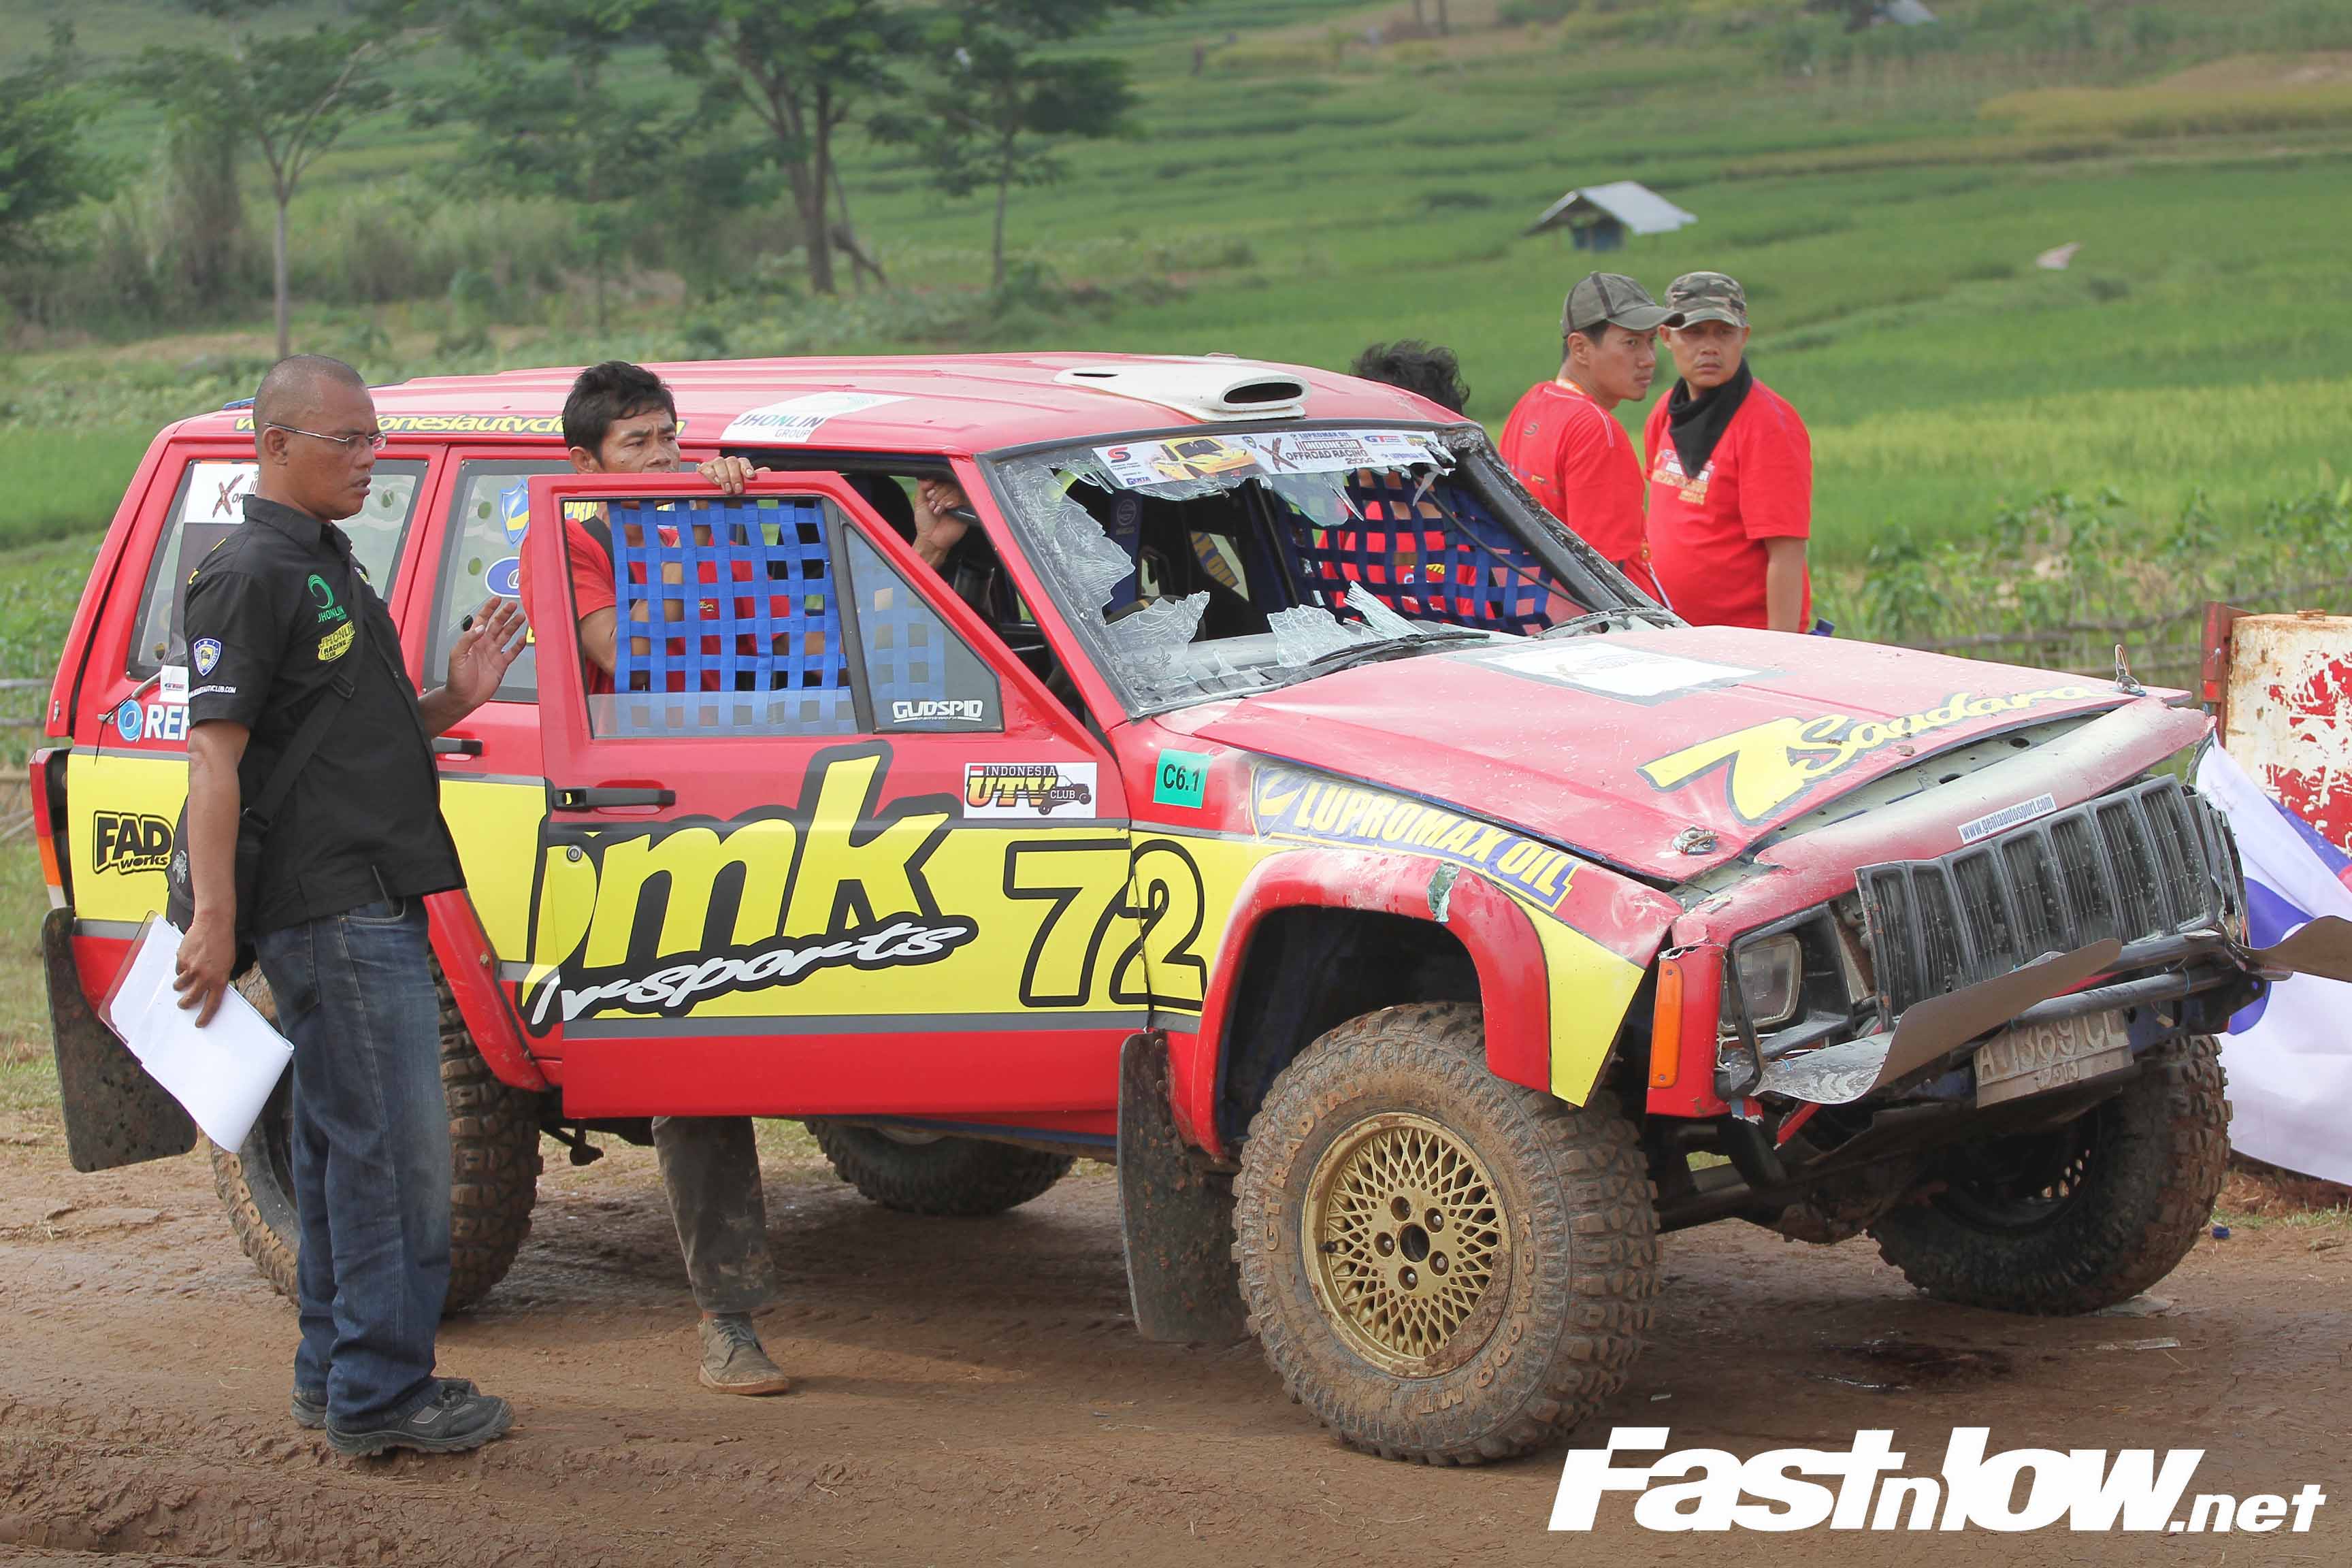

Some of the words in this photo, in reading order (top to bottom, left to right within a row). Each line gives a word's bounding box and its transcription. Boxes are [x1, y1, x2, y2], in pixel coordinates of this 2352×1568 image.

[733, 414, 826, 428] JHONLIN
[775, 429, 811, 438] GROUP
[1285, 450, 1332, 461] OFFROAD
[985, 766, 1057, 777] INDONESIA
[1162, 764, 1201, 792] C6.1
[966, 775, 1059, 808] UTV
[1050, 789, 1076, 800] CLUB
[96, 816, 173, 868] FAD
[1294, 781, 1508, 863] LUPROMAX
[1497, 840, 1572, 898] OIL
[120, 854, 169, 869] works
[1004, 838, 1208, 1010] 72
